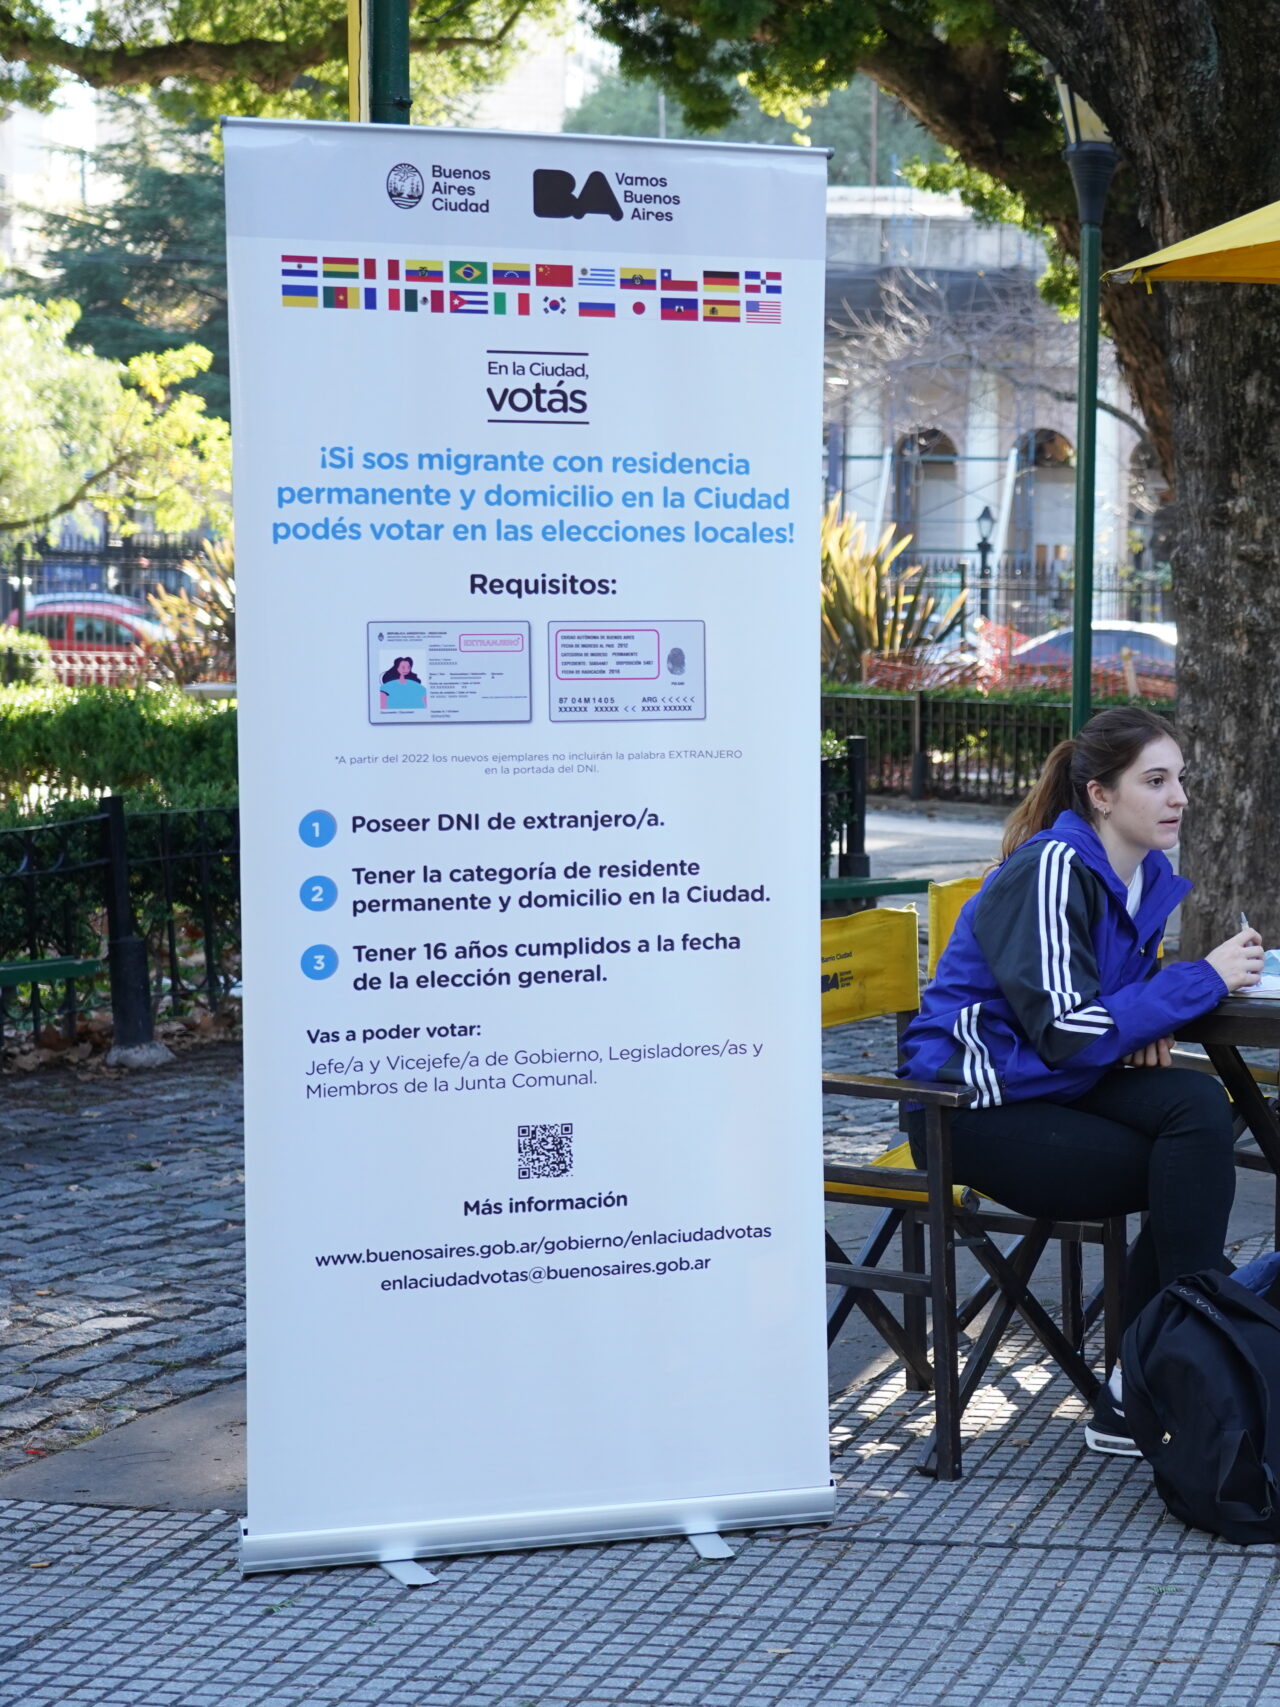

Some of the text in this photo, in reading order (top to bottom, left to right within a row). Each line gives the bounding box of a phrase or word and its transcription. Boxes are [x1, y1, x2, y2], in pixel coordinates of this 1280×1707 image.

[431, 164, 491, 181] Buenos
[615, 172, 668, 188] Vamos
[431, 182, 476, 197] Aires
[532, 169, 623, 222] BA
[624, 190, 681, 207] Buenos
[431, 197, 489, 213] Ciudad
[631, 208, 673, 222] Aires
[487, 361, 589, 380] En la Ciudad,
[486, 379, 587, 414] votás
[320, 445, 750, 476] ¡Si sos migrante con residencia
[277, 483, 789, 511] permanente y domicilio en la Ciudad
[272, 516, 794, 545] podés votar en las elecciones locales!
[470, 573, 616, 599] Requisitos:
[349, 754, 379, 765] partir
[381, 754, 398, 764] del
[401, 753, 429, 763] 2022
[432, 753, 448, 763] los
[450, 754, 489, 763] nuevos
[491, 752, 550, 763] ejemplares
[552, 753, 566, 761] no
[568, 751, 613, 761] incluirán
[615, 751, 624, 760] la
[627, 751, 666, 761] palabra
[668, 749, 743, 759] EXTRANJERO
[484, 764, 599, 776] en la portada del DNI.
[312, 821, 320, 838] 1
[352, 807, 664, 833] Poseer DNI de extranjero/a.
[351, 859, 700, 885] Tener la categoría de residente
[311, 885, 324, 902] 2
[352, 884, 770, 917] permanente y domicilio en la Ciudad.
[352, 932, 740, 963] Tener 16 años cumplidos a la fecha
[313, 955, 325, 971] 3
[353, 963, 607, 991] de la elección general.
[306, 1023, 481, 1044] Vas a poder votar:
[305, 1038, 763, 1076] Jefe/a y Vicejefe/a de Gobierno, Legisladores/as y
[306, 1069, 597, 1099] Miembros de la Junta Comunal.
[463, 1190, 628, 1216] Más información
[315, 1224, 772, 1267] www.buenosaires.gob.ar/gobierno/enlaciudadvotas
[380, 1256, 711, 1291] enlaciudadvotas@buenosaires.gob.ar
